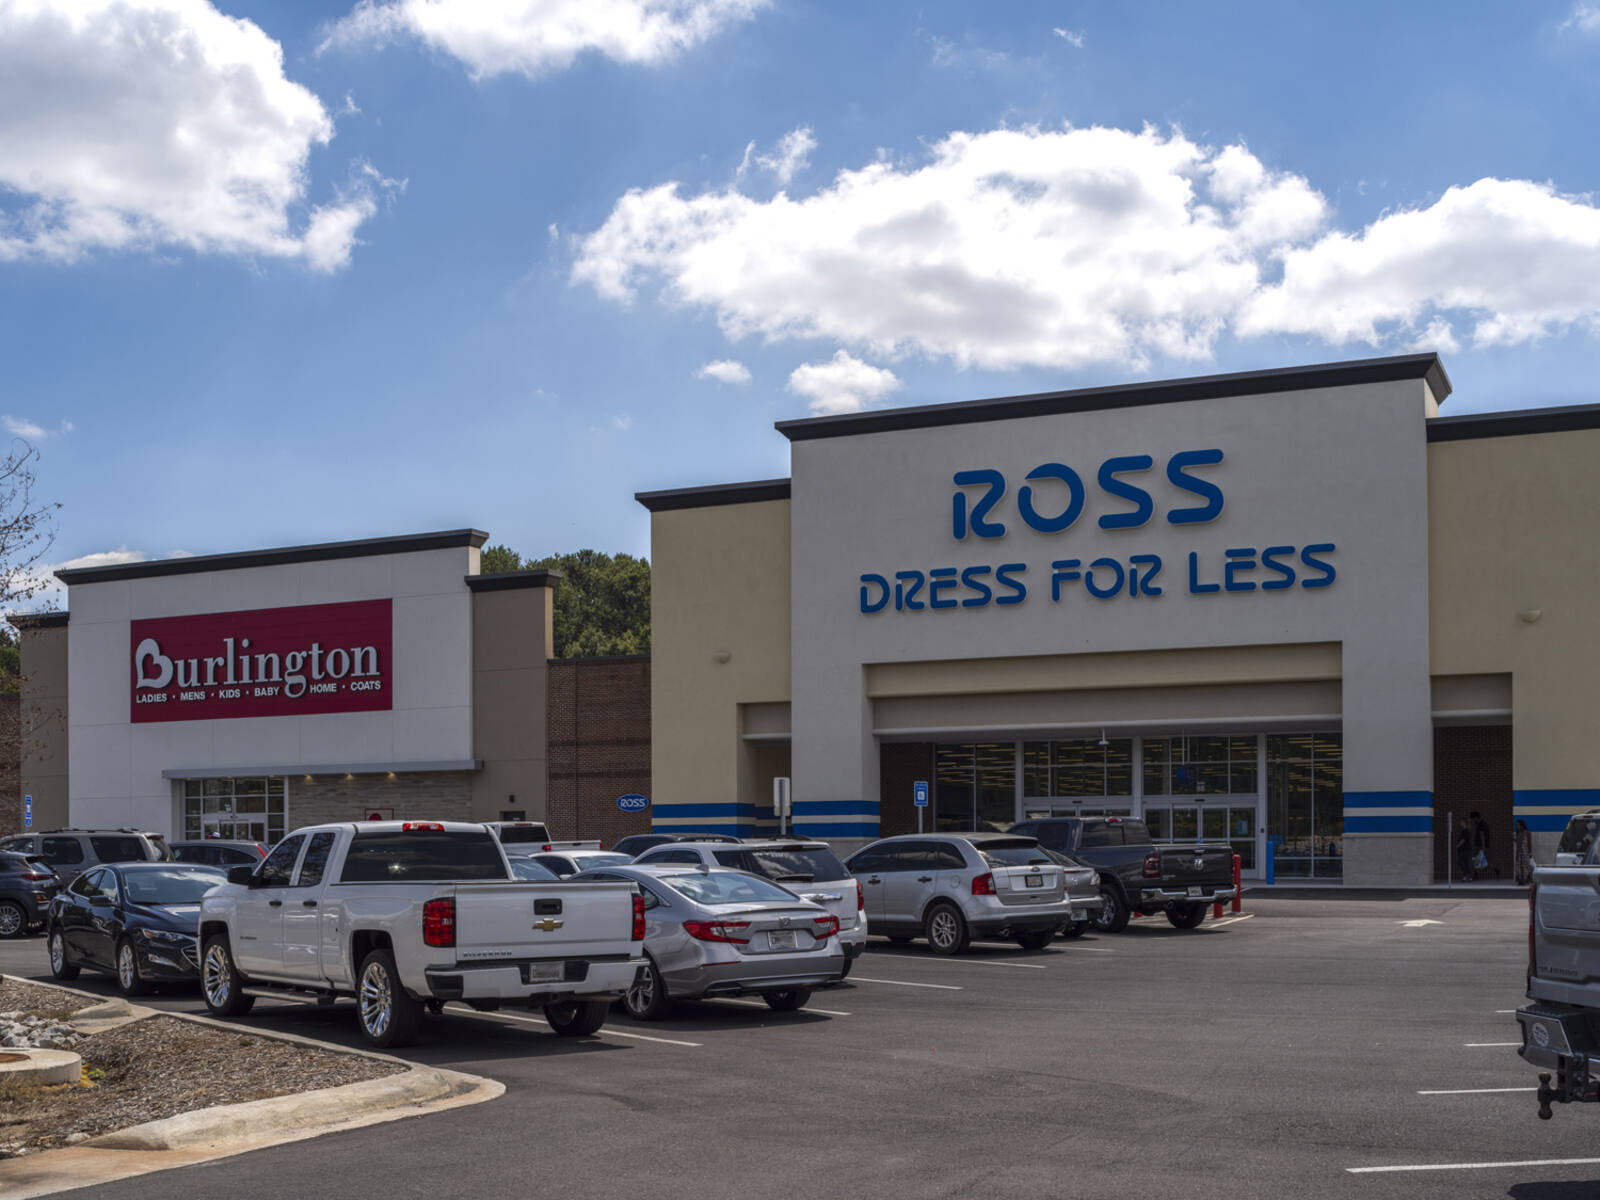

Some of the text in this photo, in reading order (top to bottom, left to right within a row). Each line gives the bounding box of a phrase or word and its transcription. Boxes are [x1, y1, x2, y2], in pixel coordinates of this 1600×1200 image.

[953, 448, 1225, 541] ROSS
[860, 543, 1337, 613] DRESS FOR LESS
[135, 637, 381, 698] Burlington
[136, 681, 382, 704] LADIES MENS KIDS BABY HOME COATS
[620, 798, 646, 808] ROSS
